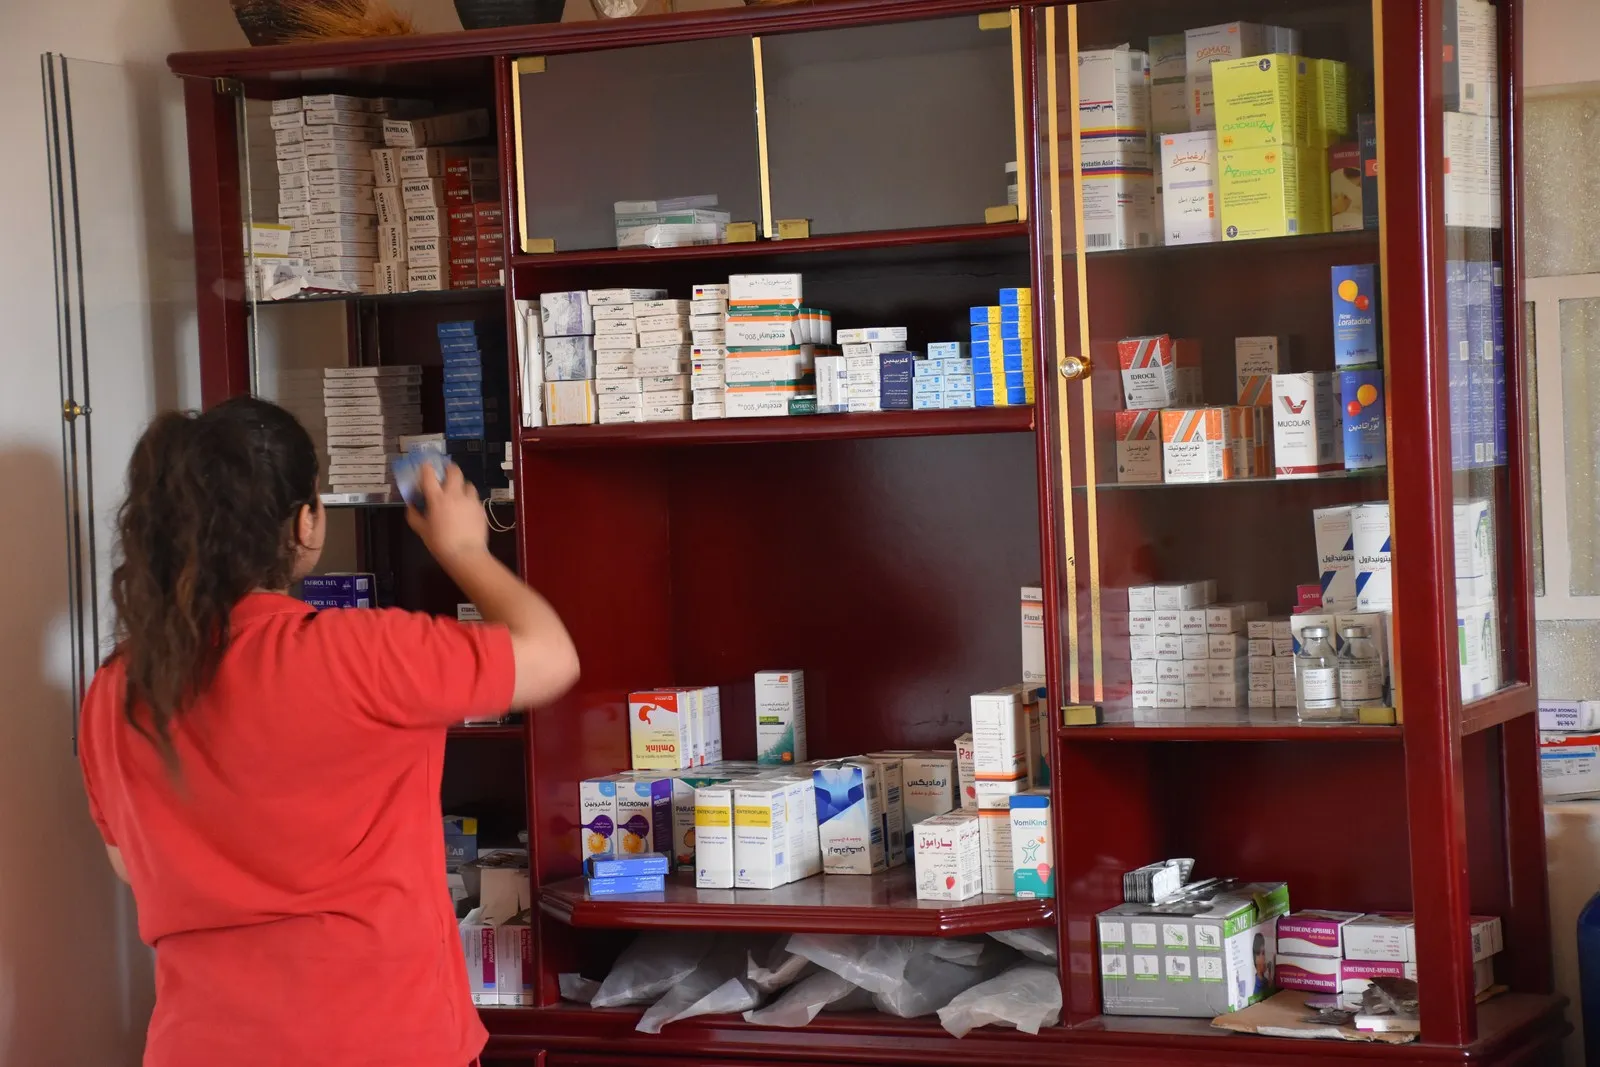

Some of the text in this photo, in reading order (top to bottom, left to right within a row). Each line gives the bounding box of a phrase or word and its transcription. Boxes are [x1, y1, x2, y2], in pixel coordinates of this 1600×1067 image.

[404, 184, 430, 192] KIMILOX
[409, 214, 435, 222] KIMILOX
[410, 243, 436, 252] KIMILOX
[1338, 318, 1372, 326] Loratadine
[1130, 372, 1156, 380] IDROCIL
[1278, 420, 1310, 428] MUCOLAR
[646, 744, 675, 753] Omlink
[1014, 818, 1048, 826] VomiKind
